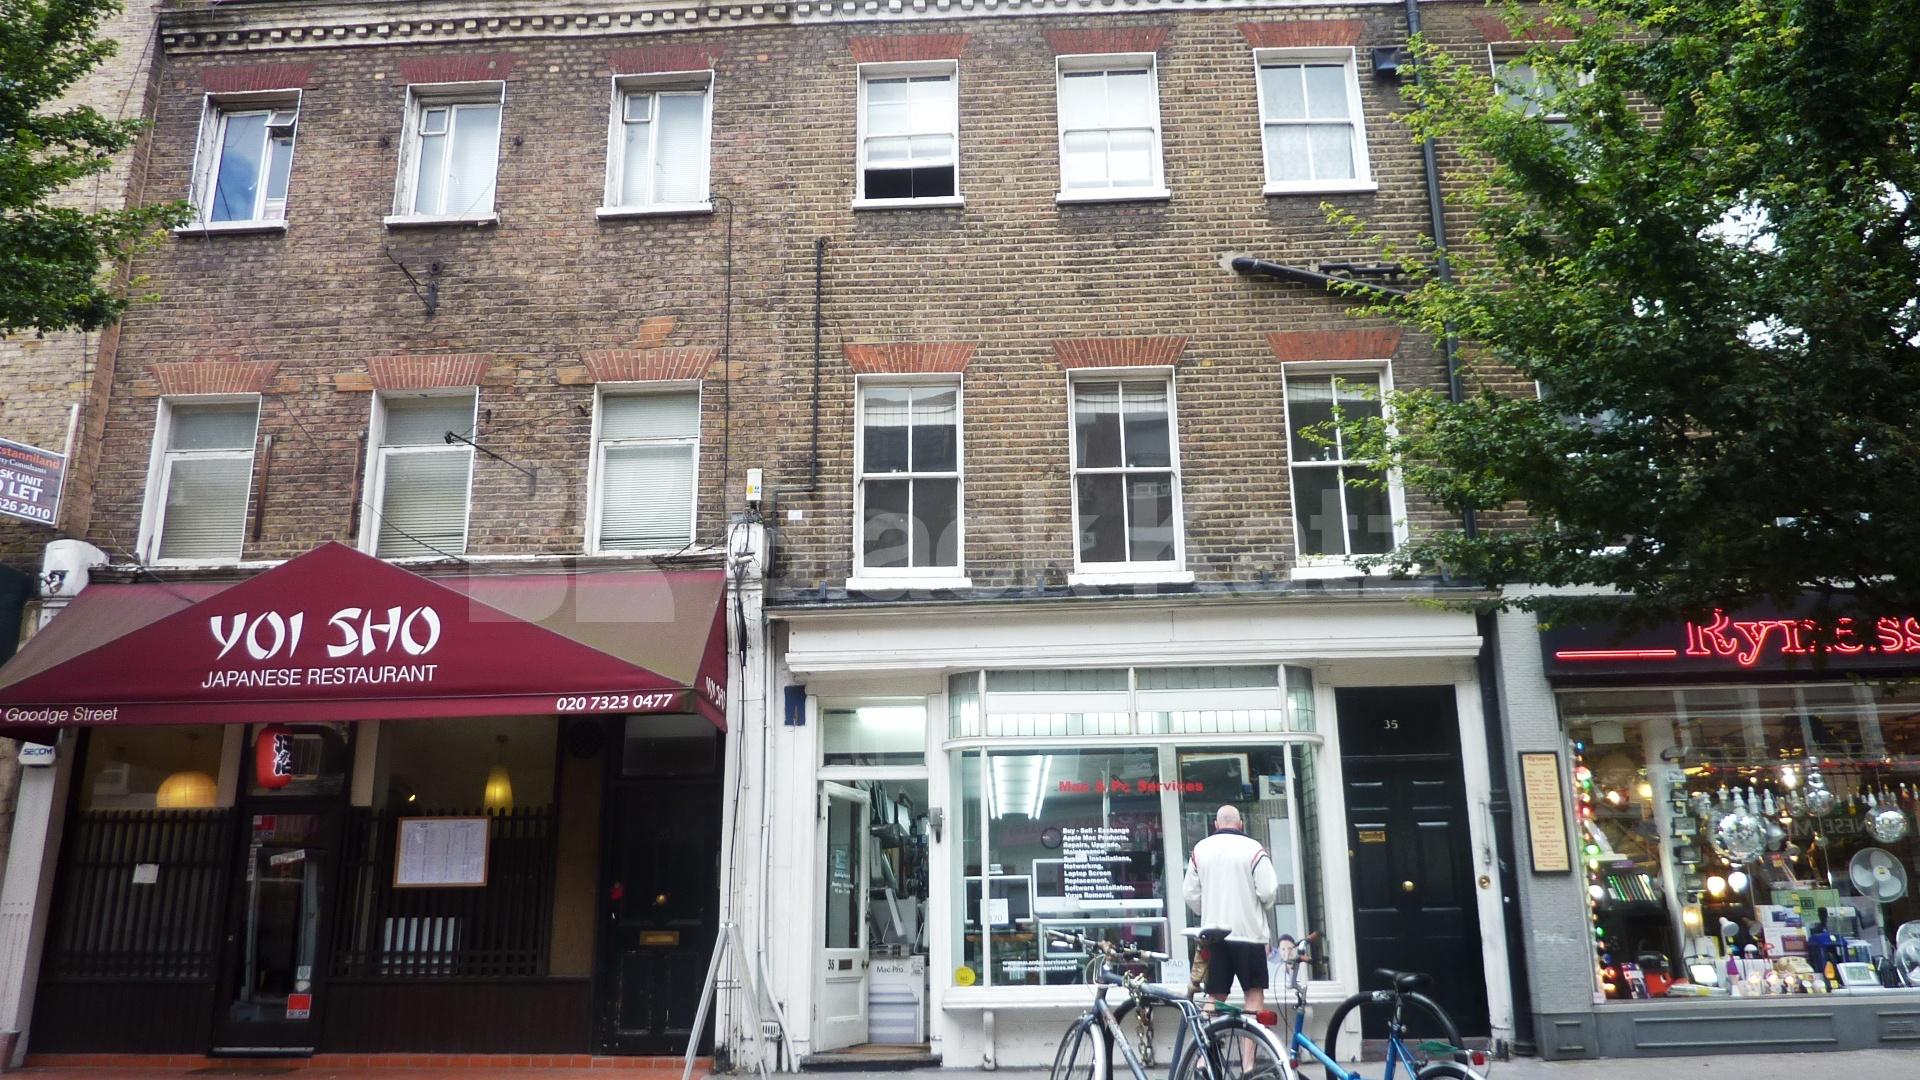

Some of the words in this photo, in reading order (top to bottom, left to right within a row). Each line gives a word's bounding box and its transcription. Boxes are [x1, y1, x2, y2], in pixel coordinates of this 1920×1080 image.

[0, 447, 60, 470] stanniland
[17, 473, 43, 487] UNIT
[8, 481, 43, 502] LET
[19, 503, 51, 520] 2010
[210, 611, 304, 661] YOI
[326, 606, 441, 658] SHO
[202, 669, 302, 688] JAPANESE
[307, 664, 438, 685] RESTAURANT
[556, 697, 586, 711] 020
[590, 697, 628, 710] 7323
[632, 693, 673, 708] 0477
[5, 707, 69, 725] Goodge
[73, 706, 119, 721] Street
[1383, 719, 1399, 729] 35
[23, 747, 53, 756] SECOM
[1137, 780, 1204, 793] Services
[1062, 827, 1076, 835] Buy
[1097, 827, 1130, 835] Exchange
